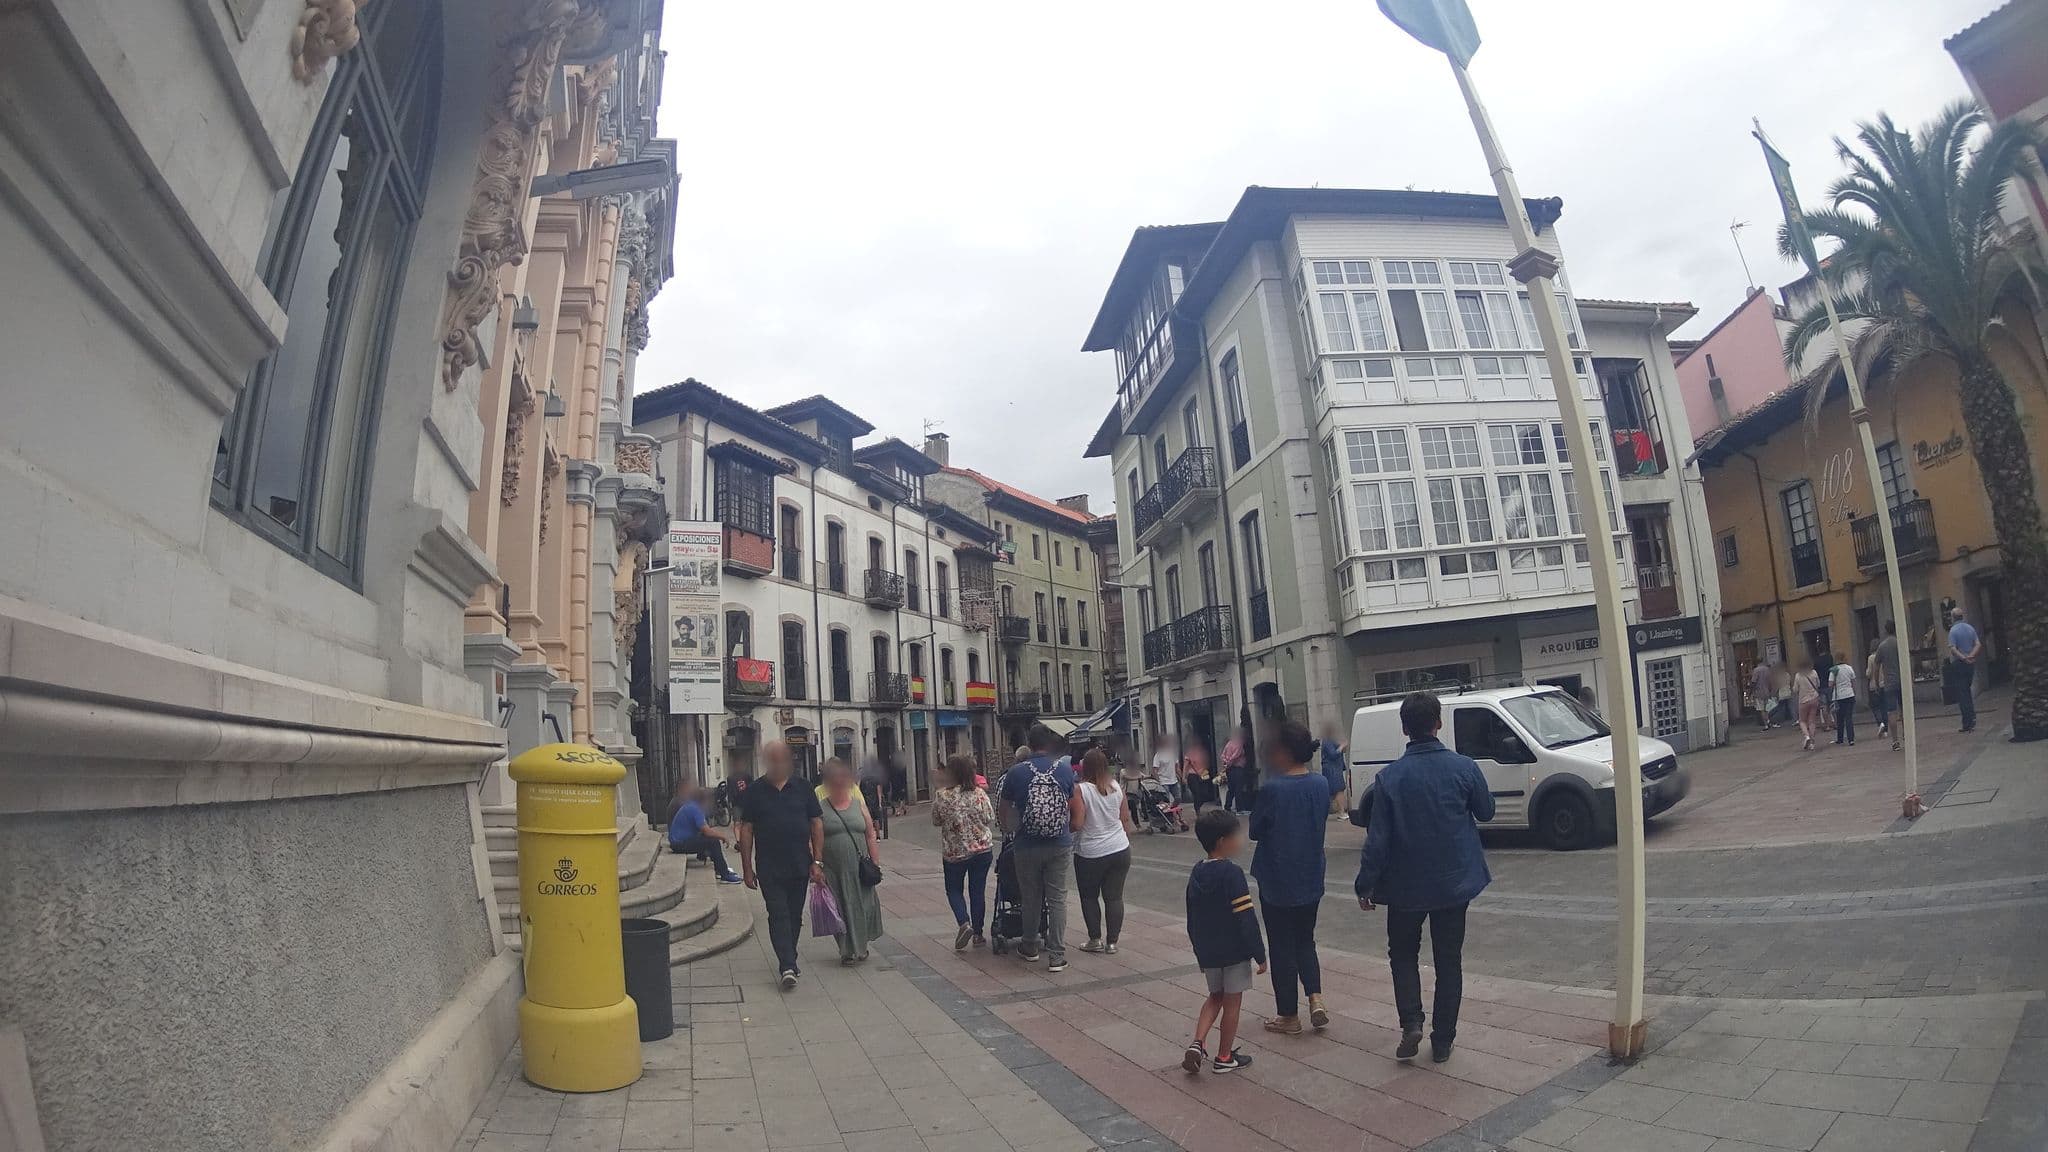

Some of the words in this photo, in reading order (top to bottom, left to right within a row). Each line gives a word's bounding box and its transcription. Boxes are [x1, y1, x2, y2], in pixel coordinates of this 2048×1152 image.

[1821, 447, 1853, 503] 108
[671, 535, 720, 544] EXPOSICIONES
[1540, 638, 1599, 654] ARQUITEC
